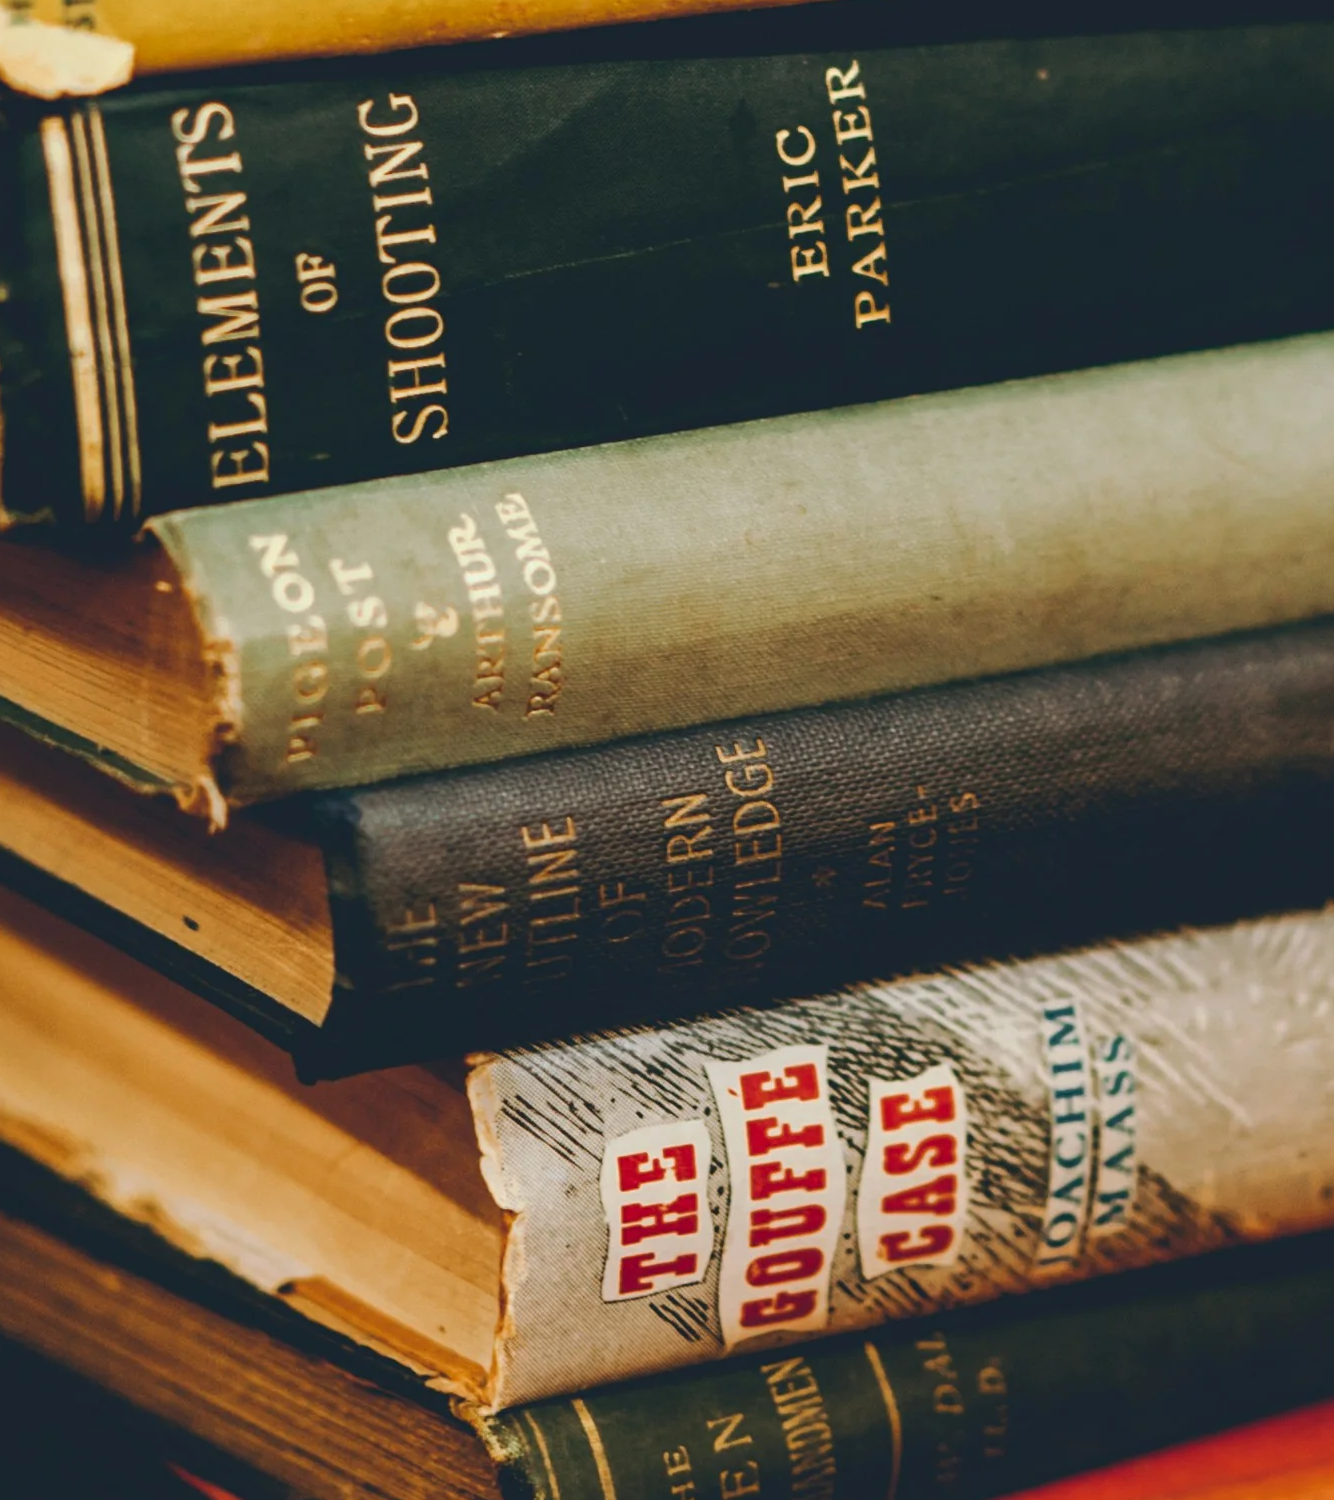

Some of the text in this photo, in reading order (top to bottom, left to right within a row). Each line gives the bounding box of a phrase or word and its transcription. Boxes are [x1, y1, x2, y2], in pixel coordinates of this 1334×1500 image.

[295, 251, 338, 314] OF
[357, 90, 449, 446] SHOOTING
[775, 123, 830, 284] ERIC
[825, 59, 891, 329] PARKER
[171, 99, 269, 491] ELEMENTS
[248, 532, 329, 764] PIGEON
[329, 557, 393, 716] POST
[447, 511, 505, 715] ARTHUR
[494, 491, 563, 722] RANSOME
[861, 820, 897, 910] ALAN
[617, 1143, 698, 1296] THE
[876, 1085, 957, 1263] CASE
[1040, 1004, 1086, 1268] JOACHIM
[1094, 1034, 1137, 1229] MAASS
